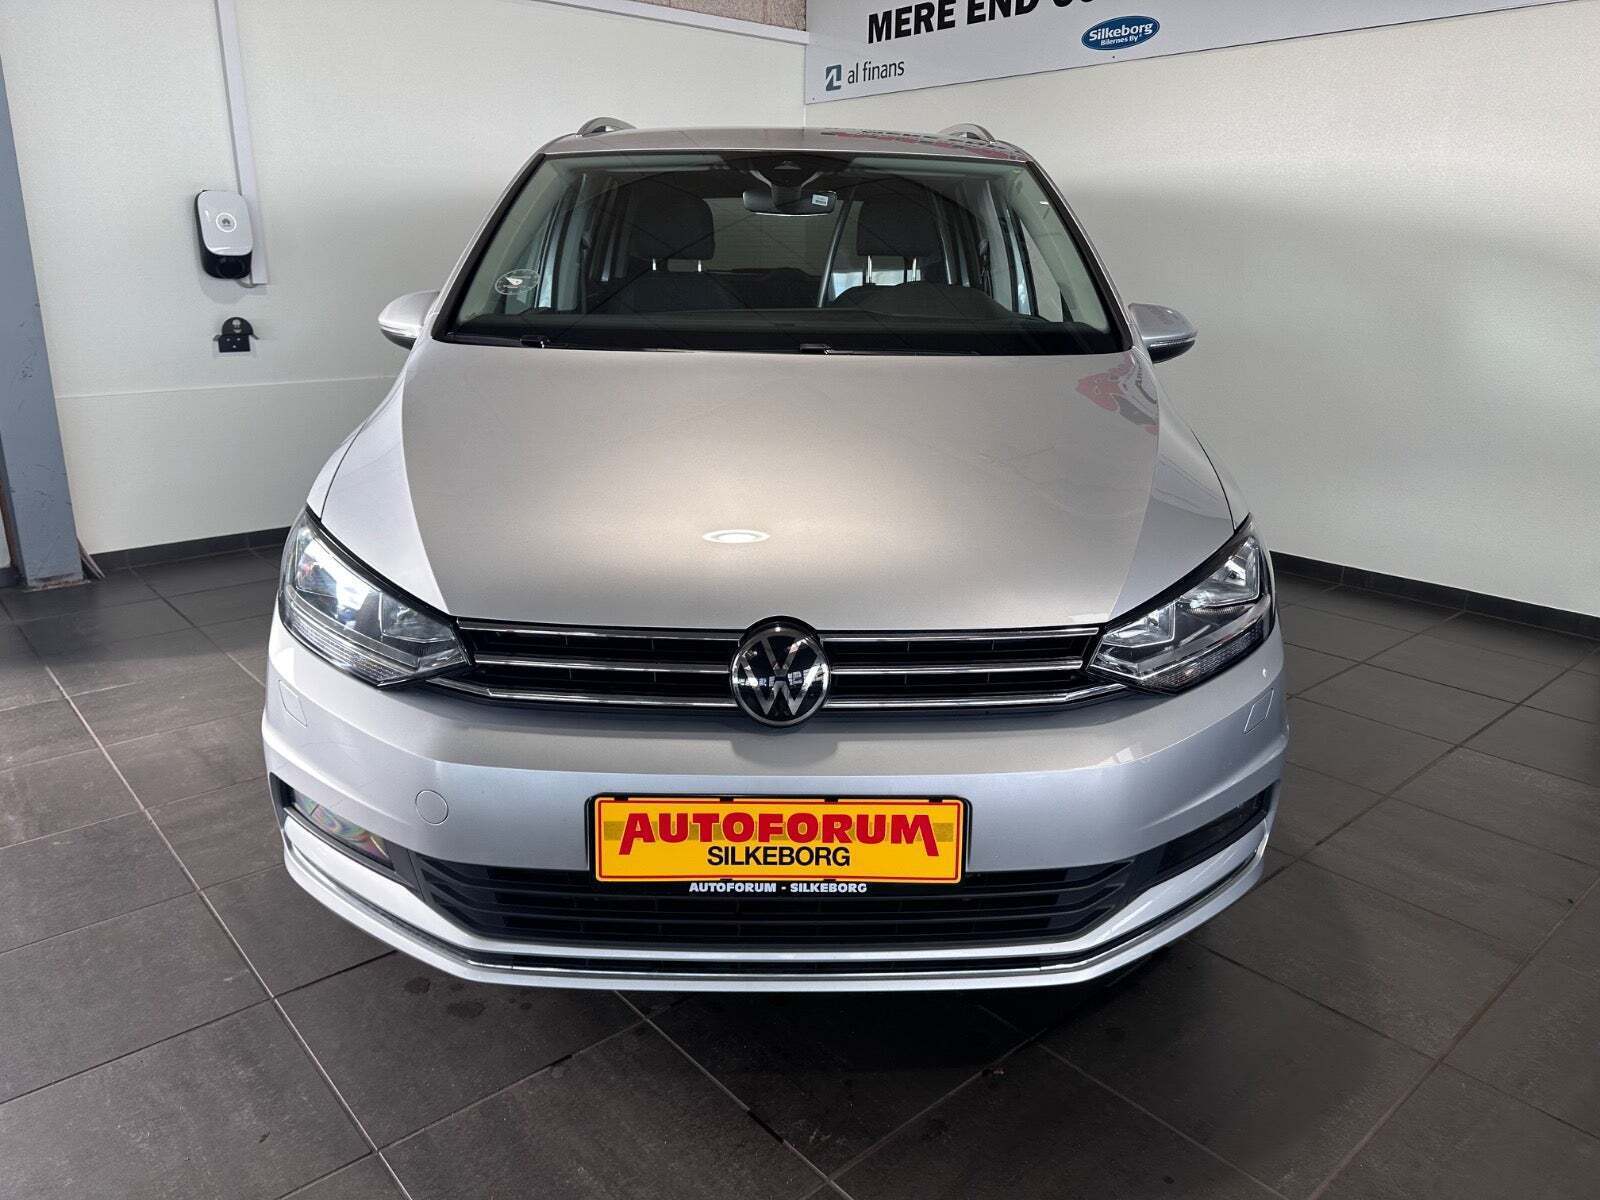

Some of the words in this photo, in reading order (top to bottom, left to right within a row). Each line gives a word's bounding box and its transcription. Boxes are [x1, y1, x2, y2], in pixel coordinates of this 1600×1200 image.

[868, 0, 956, 44] MERE
[1089, 22, 1154, 41] Silkeborg
[847, 62, 859, 84] al
[862, 61, 905, 82] finans
[618, 812, 939, 857] AUTOFORUM
[707, 846, 850, 866] SILKEBORG
[689, 882, 777, 893] AUTOFORUM
[790, 882, 868, 893] SILKEBORG
